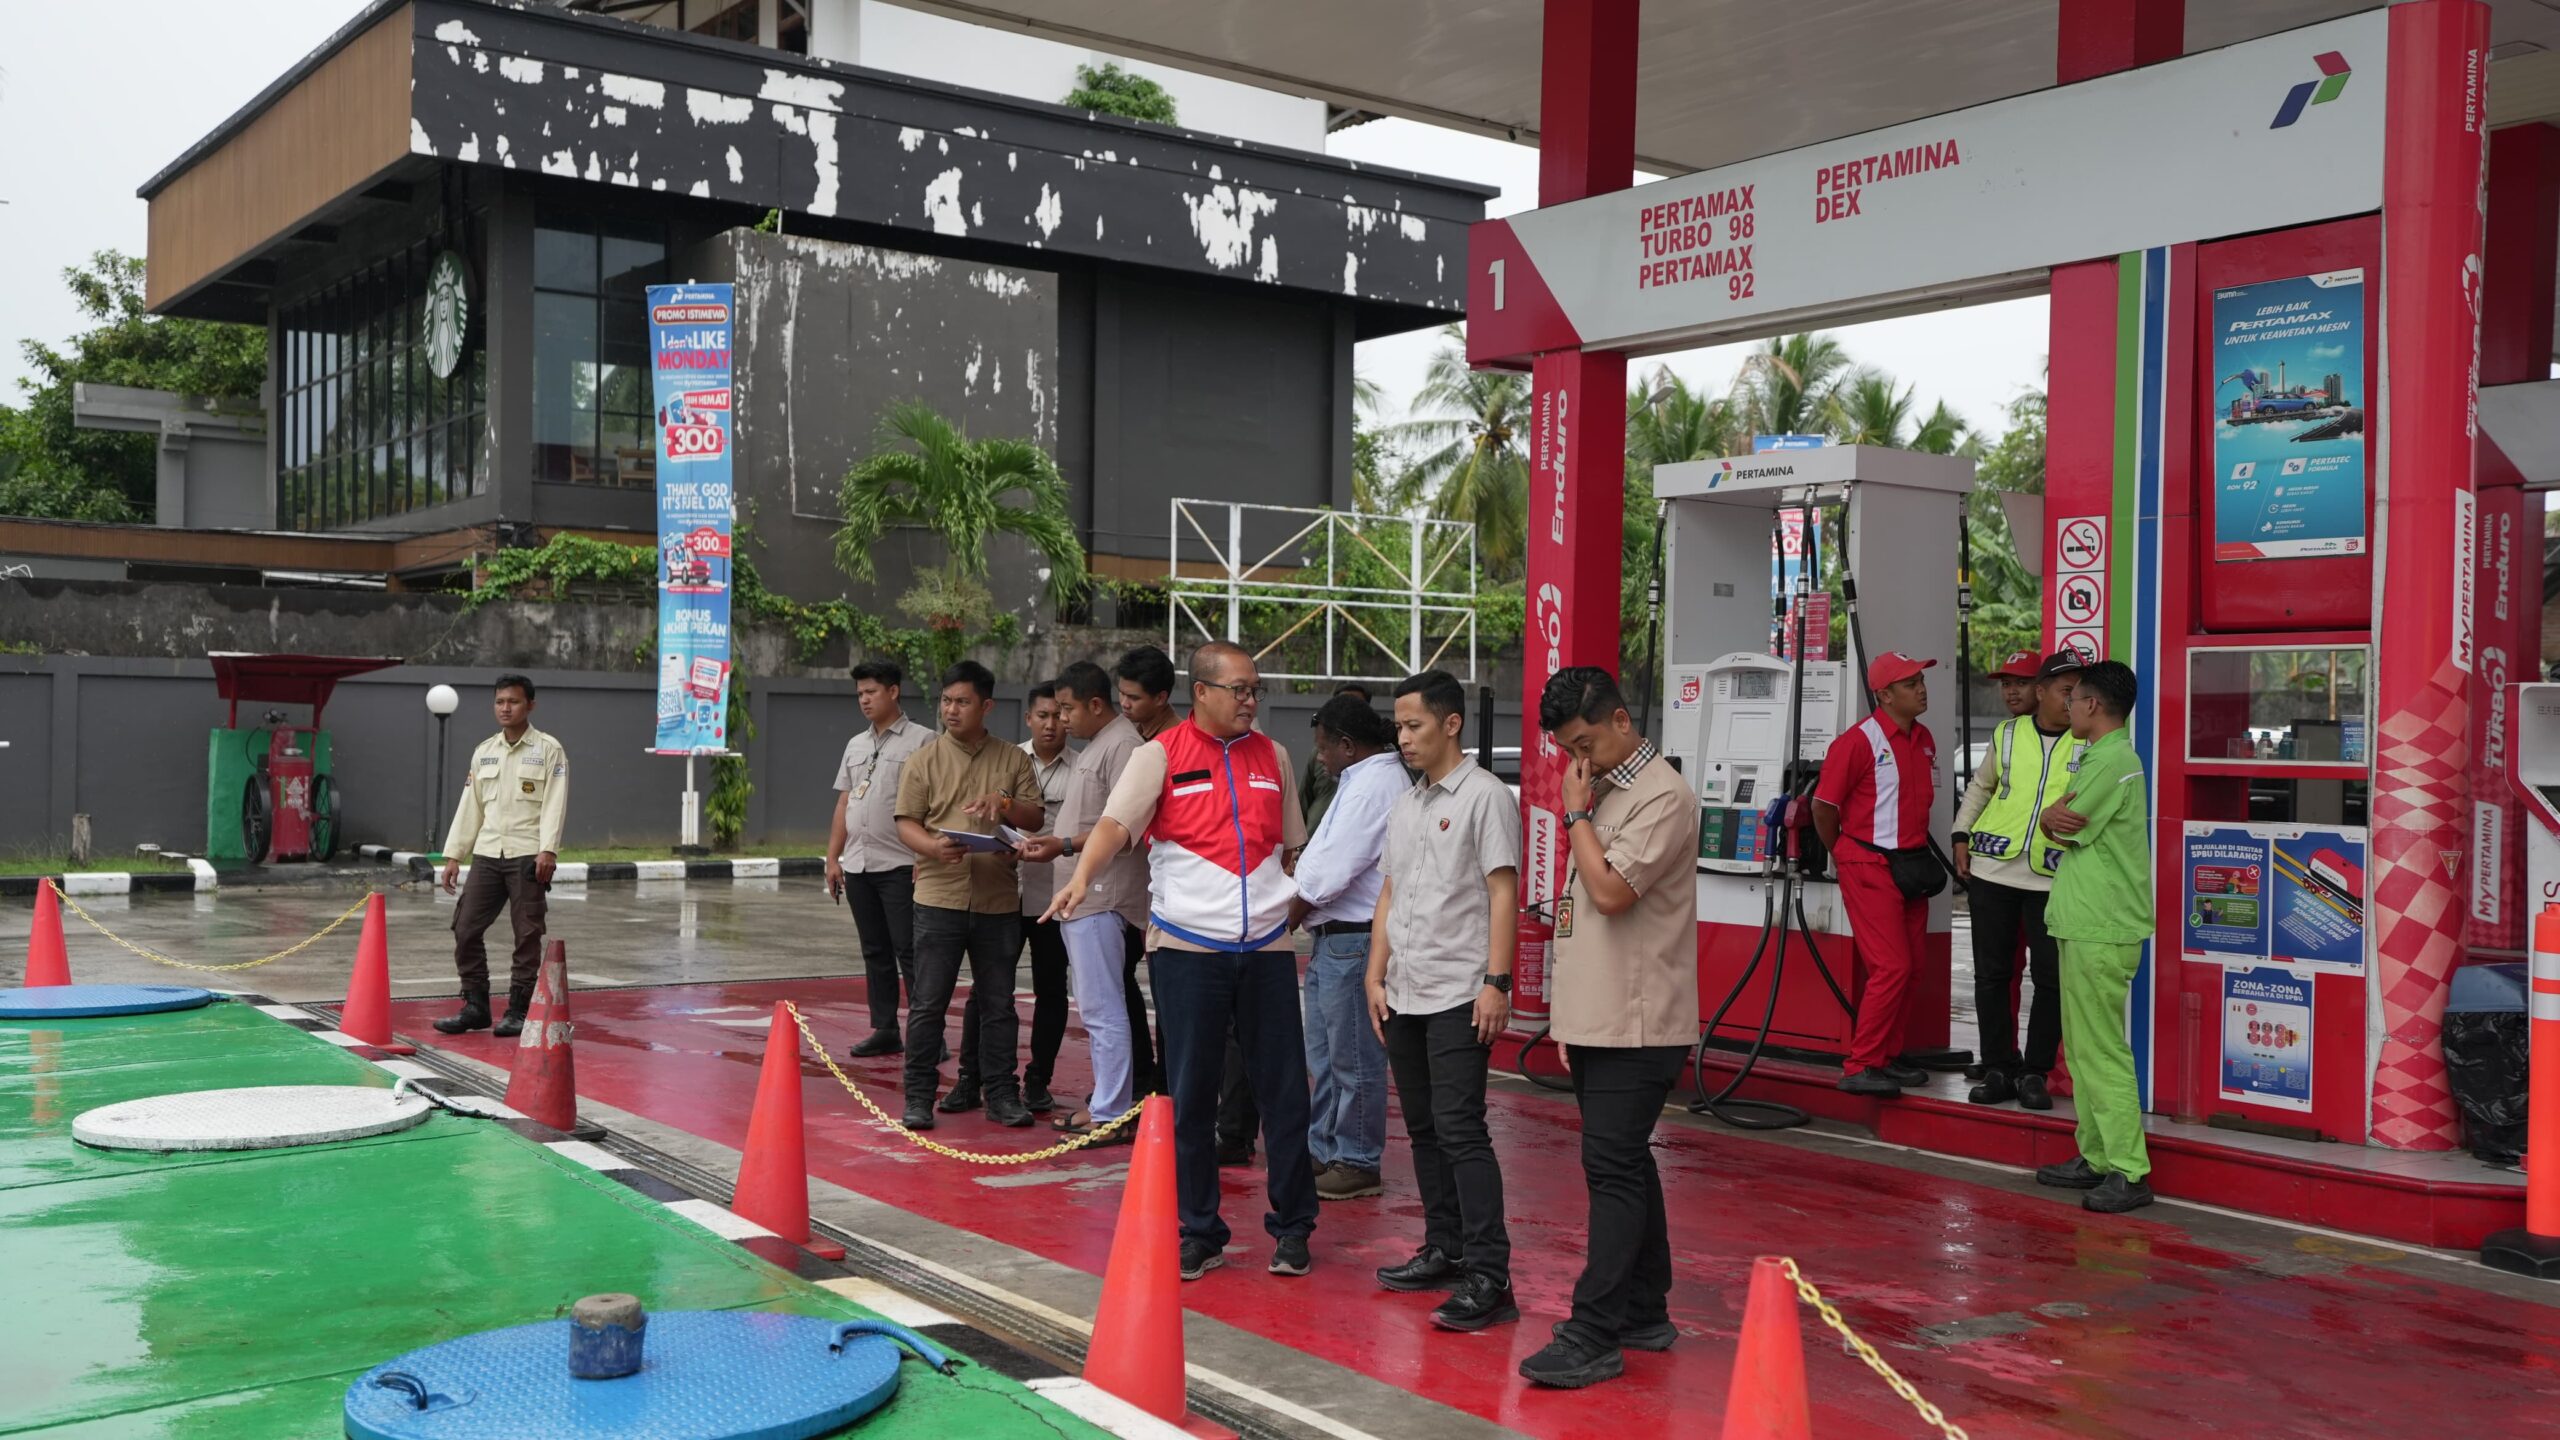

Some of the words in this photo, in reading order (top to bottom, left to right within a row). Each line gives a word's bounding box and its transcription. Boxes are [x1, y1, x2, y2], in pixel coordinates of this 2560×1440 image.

[2465, 49, 2478, 132] PERTAMINA
[1816, 139, 1960, 195] PERTAMINA
[1640, 184, 1755, 232] PERTAMAX
[1816, 189, 1861, 224] DEX
[1641, 222, 1712, 258] TURBO
[1729, 213, 1754, 240] 98
[1639, 245, 1753, 289] PERTAMAX
[1488, 259, 1505, 311] 1
[1729, 272, 1754, 300] 92
[656, 309, 686, 320] PROMO
[687, 308, 726, 320] ISTIMEWA
[2256, 303, 2283, 316] LEBIH
[2285, 301, 2311, 312] BAIK
[2229, 310, 2333, 332] PERTAMAX
[660, 330, 666, 349] I
[693, 330, 726, 349] LIKE
[2224, 333, 2258, 346] UNTUK
[2260, 325, 2314, 341] KEAWETAN
[2316, 321, 2351, 334] MESIN
[657, 350, 730, 370] MONDAY
[699, 393, 728, 406] HEMAT
[675, 427, 718, 453] 300
[1540, 391, 1551, 471] PERTAMINA
[1551, 389, 1567, 545] Enduro
[2310, 456, 2351, 465] PERTATEC
[1736, 465, 1795, 481] PERTAMINA
[701, 483, 728, 496] GOD
[2243, 480, 2257, 490] 92
[708, 496, 731, 510] DAY
[694, 537, 720, 551] 300
[2483, 513, 2494, 569] PERTAMINA
[2495, 512, 2511, 621] Enduro
[2459, 502, 2473, 665] MyPERTAMINA
[675, 609, 711, 622] BONUS
[690, 621, 726, 637] PEKAN
[2489, 671, 2506, 768] TURBO
[2191, 850, 2213, 858] SPBU
[2214, 851, 2263, 862] DILARANG?
[2236, 846, 2263, 854] SEKITAR
[2477, 808, 2494, 918] MyPERTAMINA
[2232, 988, 2275, 998] BERBAHAYA
[2284, 993, 2304, 1002] SPBU
[2233, 980, 2303, 996] ZONA-ZONA
